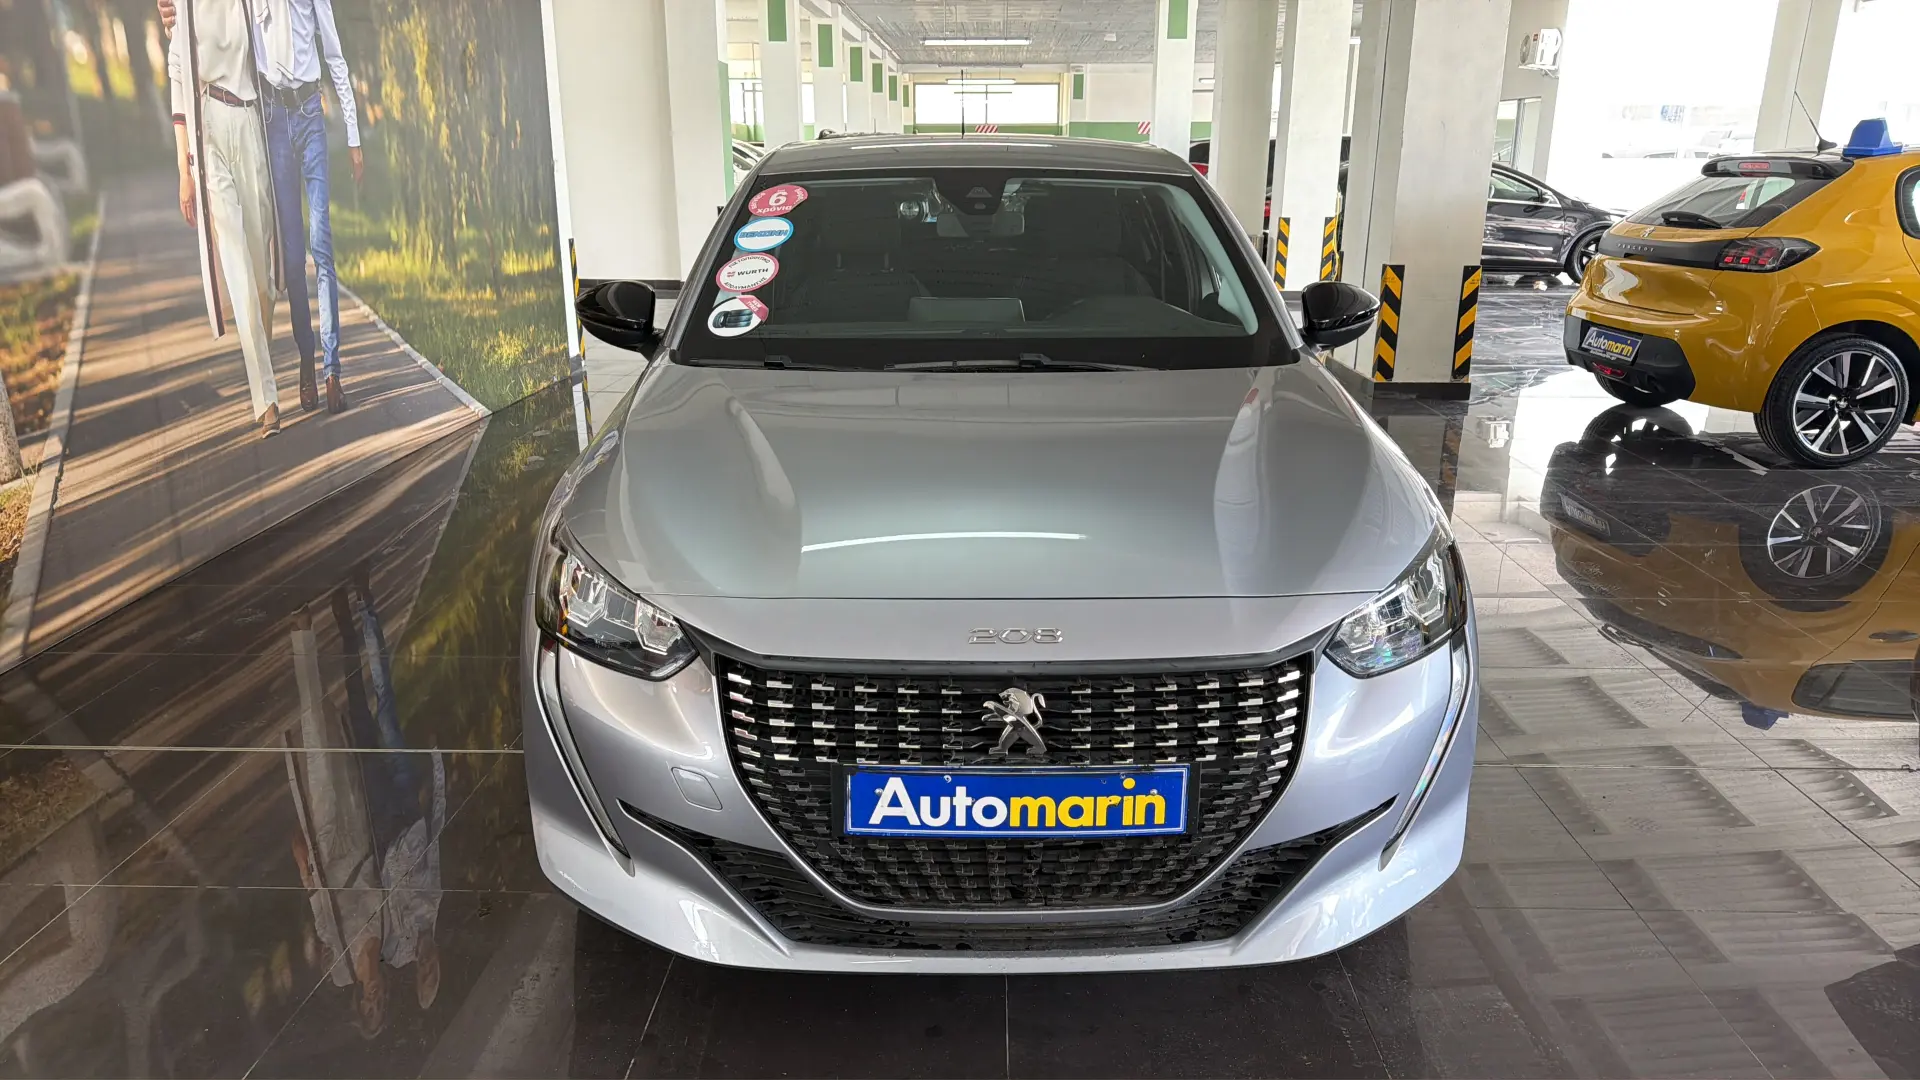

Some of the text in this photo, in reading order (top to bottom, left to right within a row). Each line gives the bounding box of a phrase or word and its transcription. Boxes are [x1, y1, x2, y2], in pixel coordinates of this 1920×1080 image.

[768, 191, 788, 206] 6
[756, 205, 792, 214] χρόνια
[1586, 331, 1633, 357] Automarin
[968, 627, 1064, 645] 208
[868, 777, 1166, 828] Automarin
